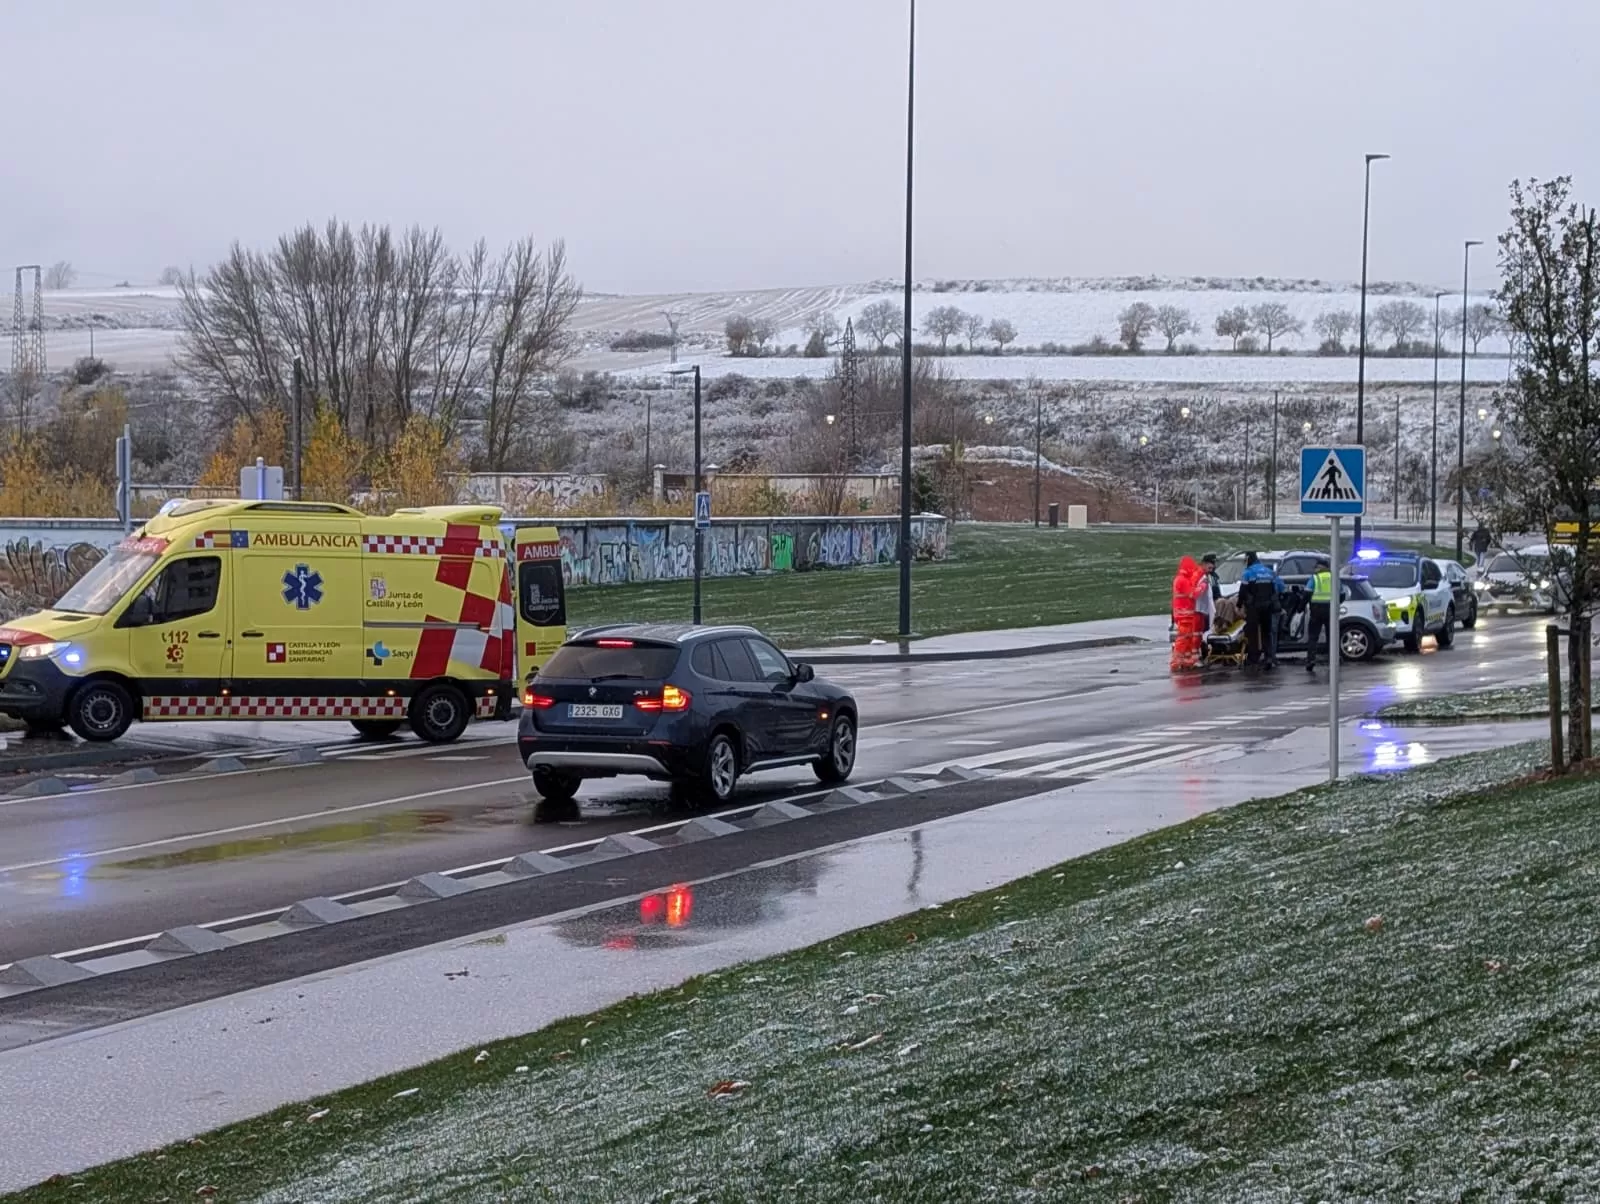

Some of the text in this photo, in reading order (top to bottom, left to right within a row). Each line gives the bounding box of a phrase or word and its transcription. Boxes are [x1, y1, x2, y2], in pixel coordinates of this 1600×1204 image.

[253, 534, 358, 548] AMBULANCIA
[388, 591, 423, 599] Junta de
[366, 599, 395, 608] Castilla
[396, 601, 401, 610] y
[168, 630, 189, 644] 112
[574, 705, 620, 717] 2325 GXG
